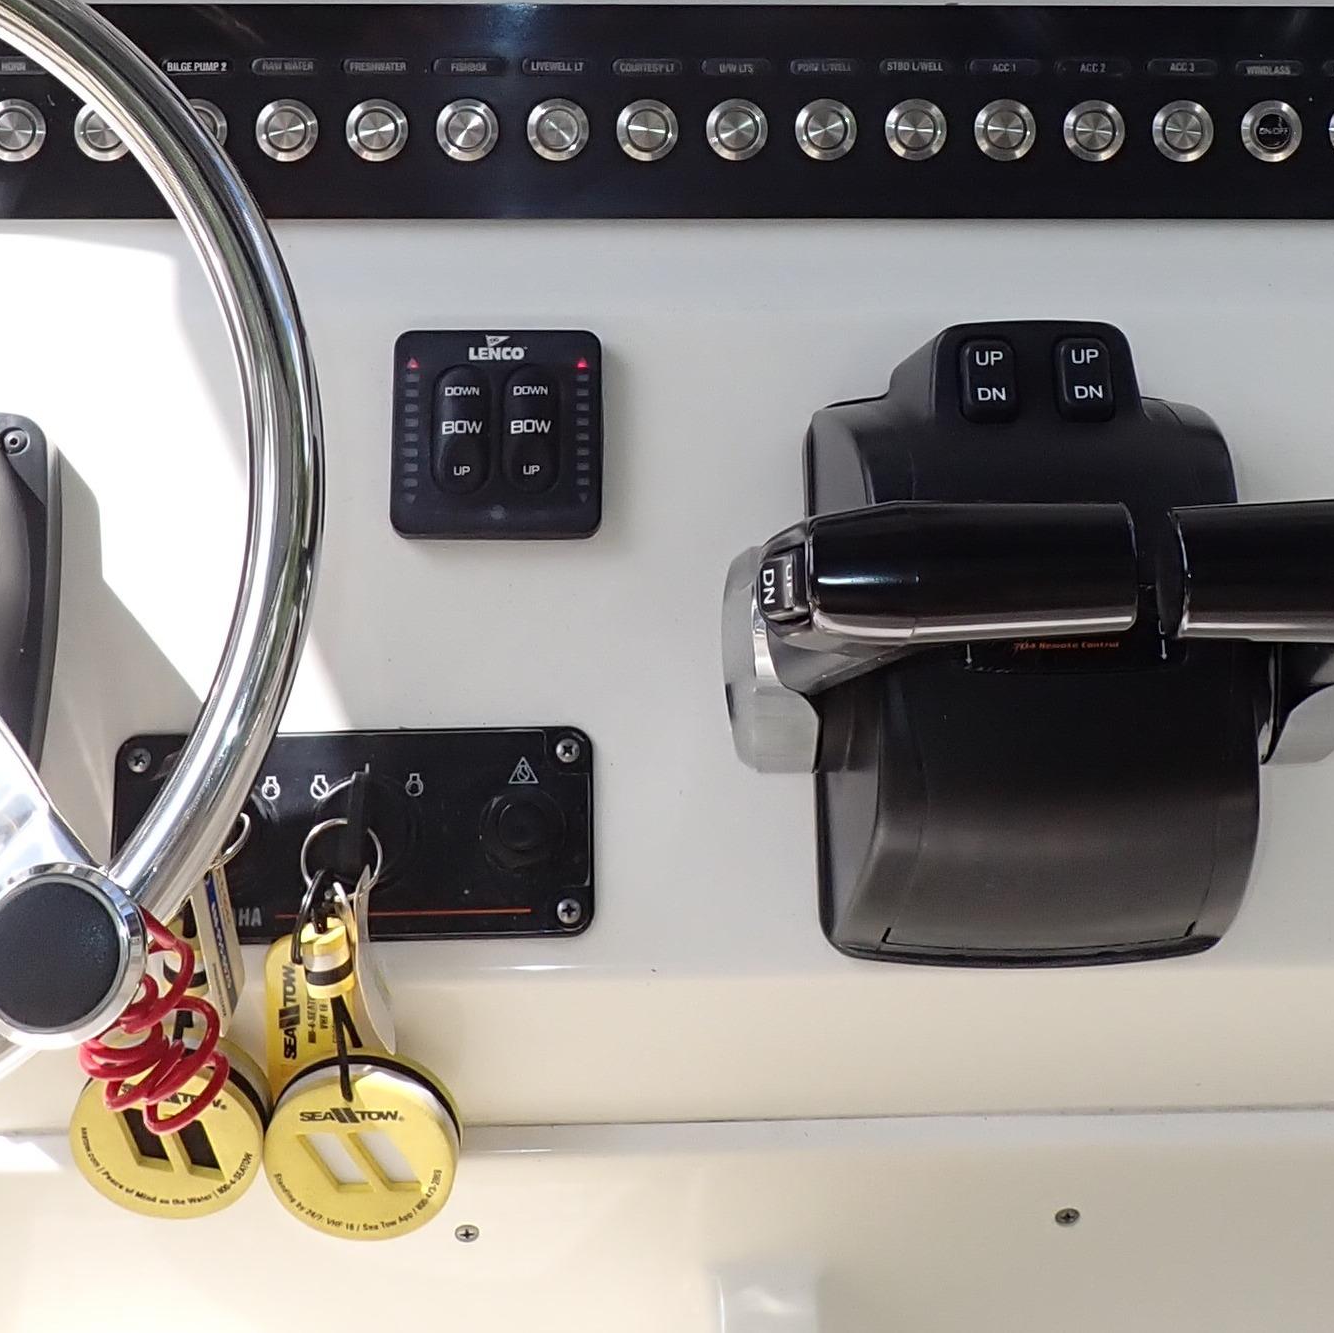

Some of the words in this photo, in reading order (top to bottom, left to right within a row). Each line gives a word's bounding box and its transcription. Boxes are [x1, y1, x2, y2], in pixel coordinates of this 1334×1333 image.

[166, 61, 191, 73] BILGE
[193, 61, 219, 73] PUMP
[220, 61, 228, 73] 2
[284, 61, 314, 73] WATER
[349, 61, 407, 73] FRESHWATER
[450, 61, 489, 73] FISHBOX
[531, 61, 570, 73] LIVEWELL
[573, 61, 584, 73] LT
[620, 61, 662, 74] COURTESY
[664, 62, 675, 74] LT
[739, 63, 754, 74] LTS
[886, 62, 910, 72] STBD
[912, 62, 943, 72] L/WELL
[992, 63, 1010, 73] ACC
[1012, 63, 1017, 73] 1
[1080, 63, 1097, 74] ACC
[1099, 63, 1107, 74] 2
[1170, 62, 1186, 72] ACC
[1188, 63, 1195, 73] 3
[1246, 65, 1291, 76] WINDLASS
[468, 346, 525, 361] LENCO
[975, 350, 1004, 366] UP
[1071, 348, 1099, 364] UP
[444, 385, 481, 397] DOWN
[513, 385, 549, 397] DOWN
[977, 387, 1006, 401] DN
[1074, 385, 1104, 399] DN
[441, 420, 483, 436] BOW
[510, 419, 552, 435] BOW
[453, 465, 471, 477] UP
[523, 465, 540, 476] UP
[763, 568, 776, 605] DN
[1039, 642, 1079, 650] Remote
[1081, 641, 1120, 649] Control
[282, 965, 296, 1007] TOW
[283, 1027, 297, 1060] SEA
[299, 1110, 336, 1122] SEA
[355, 1110, 399, 1122] TOW
[102, 1166, 124, 1190] Peace
[135, 1191, 157, 1204] Mind
[159, 1197, 170, 1205] on
[172, 1197, 186, 1206] the
[187, 1193, 214, 1206] Water
[326, 1217, 344, 1229] VHF
[362, 1222, 379, 1232] Sea
[380, 1219, 398, 1229] Tow
[398, 1211, 415, 1224] App
